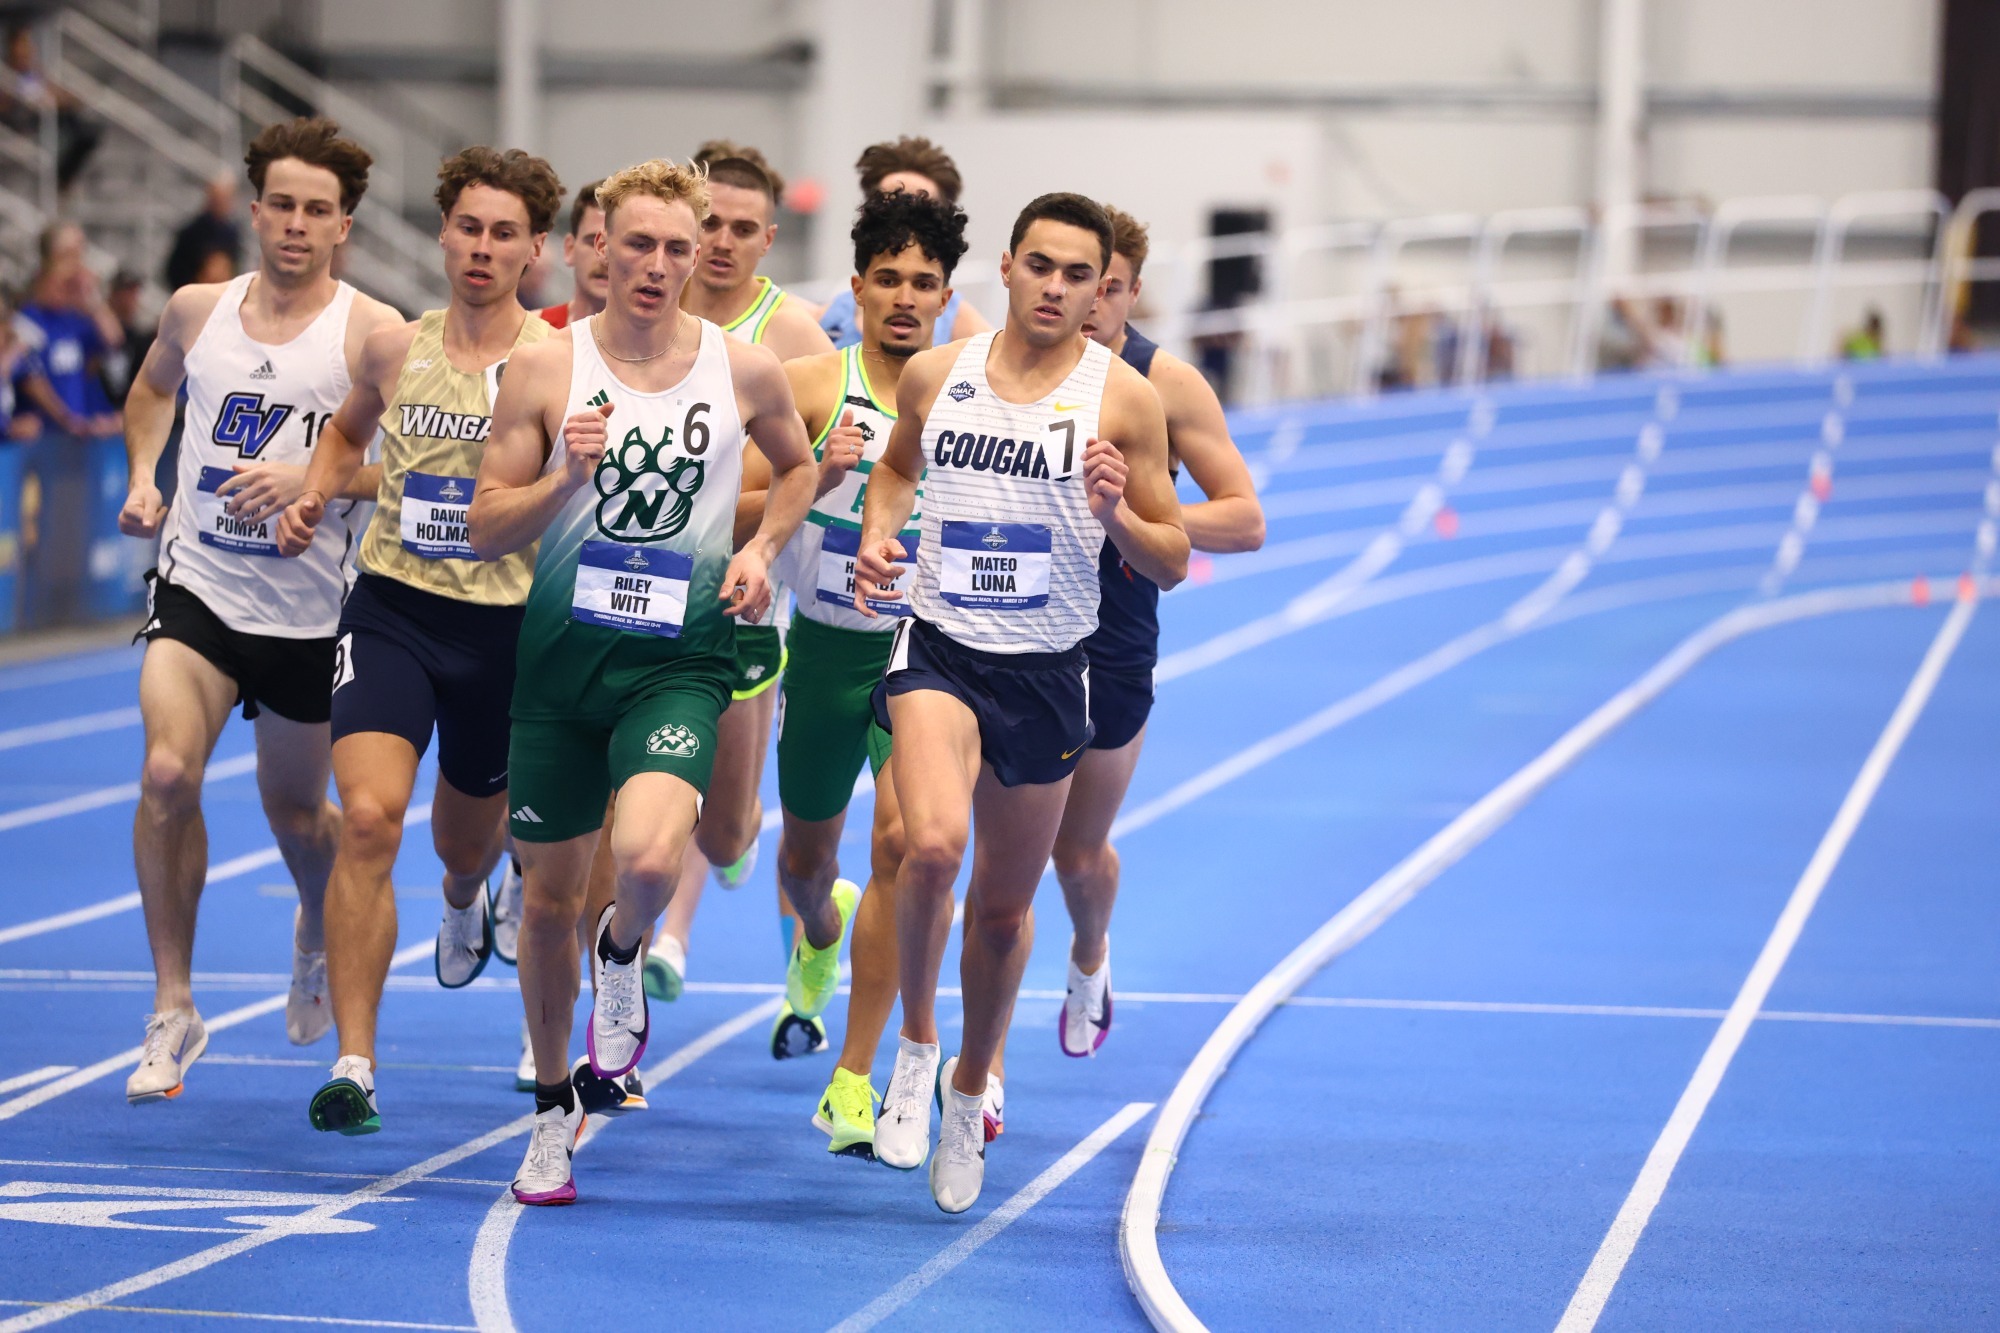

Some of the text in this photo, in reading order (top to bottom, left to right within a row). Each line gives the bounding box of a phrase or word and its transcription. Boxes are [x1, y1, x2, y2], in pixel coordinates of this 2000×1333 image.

[249, 372, 277, 380] adidas
[950, 386, 975, 398] RMAC
[212, 391, 295, 459] GV
[682, 402, 711, 456] 6
[1048, 418, 1076, 474] 7
[431, 507, 468, 524] DAVID
[216, 515, 268, 539] PUMPA
[971, 556, 1018, 572] MATEO
[614, 576, 652, 594] RILEY
[971, 573, 1017, 593] LUNA
[611, 592, 651, 615] WITT
